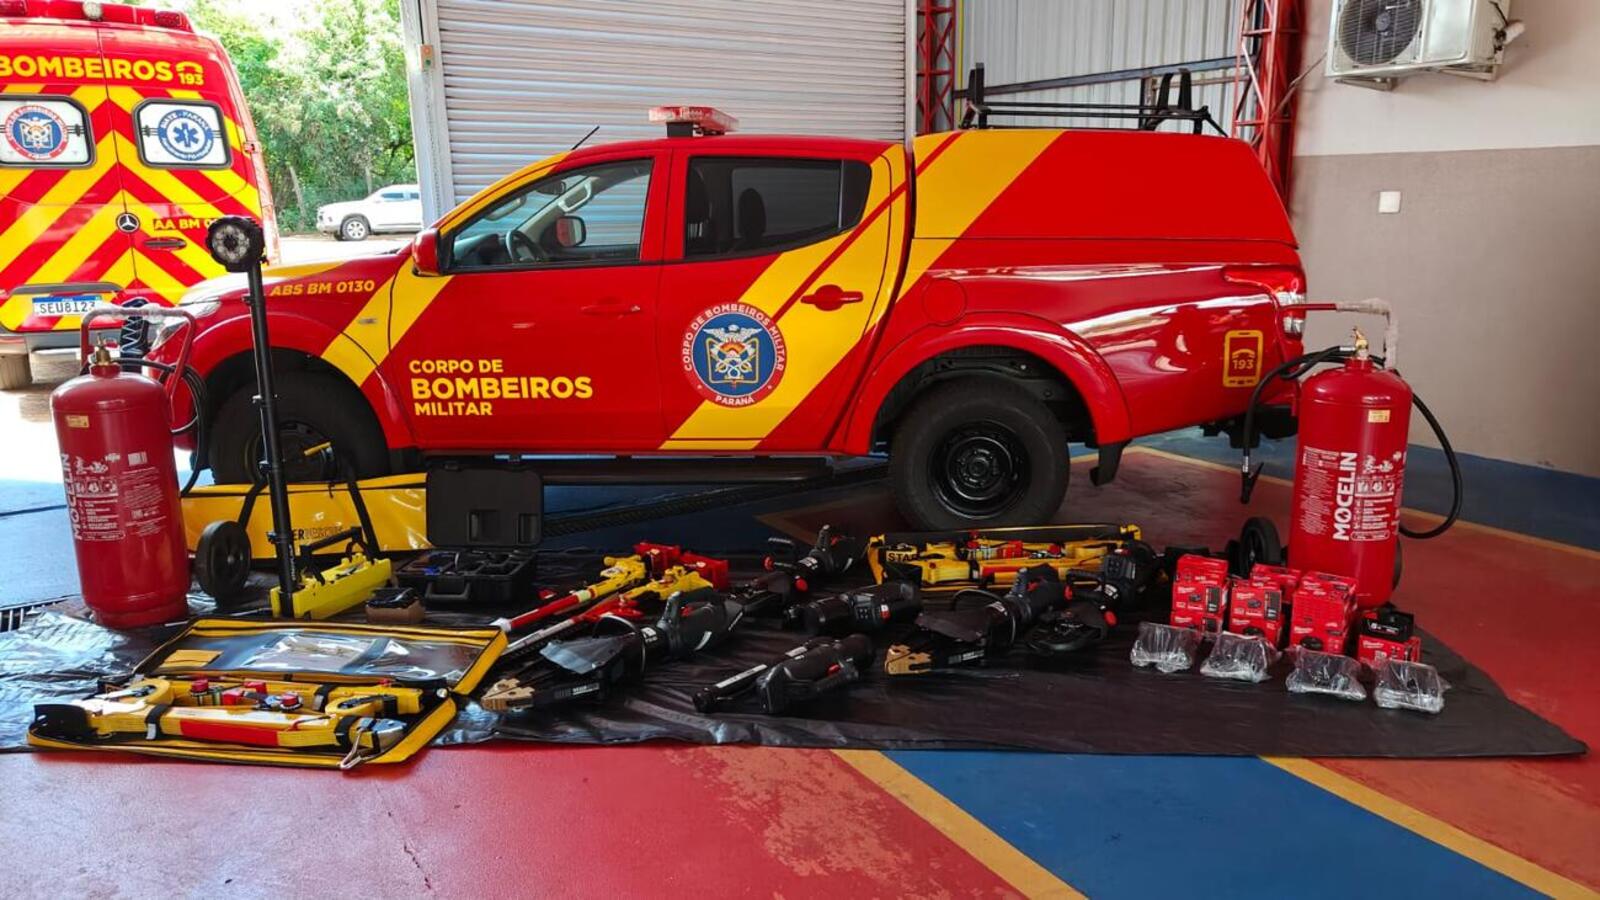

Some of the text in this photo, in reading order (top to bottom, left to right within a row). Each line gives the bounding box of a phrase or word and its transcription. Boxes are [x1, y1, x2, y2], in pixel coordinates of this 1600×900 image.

[0, 55, 173, 82] BOMBEIROS
[178, 72, 204, 86] 193
[154, 218, 176, 230] AA
[179, 218, 200, 229] BM
[270, 280, 375, 297] ABS BM 0130
[682, 303, 785, 372] CORPO DE BOMBEIROS MILITAR
[409, 359, 504, 374] CORPO DE
[1232, 359, 1254, 370] 193
[411, 376, 593, 400] BOMBEIROS
[414, 401, 493, 416] MILITAR
[60, 453, 83, 540] MOCELIN
[1332, 452, 1358, 541] MOCELIN
